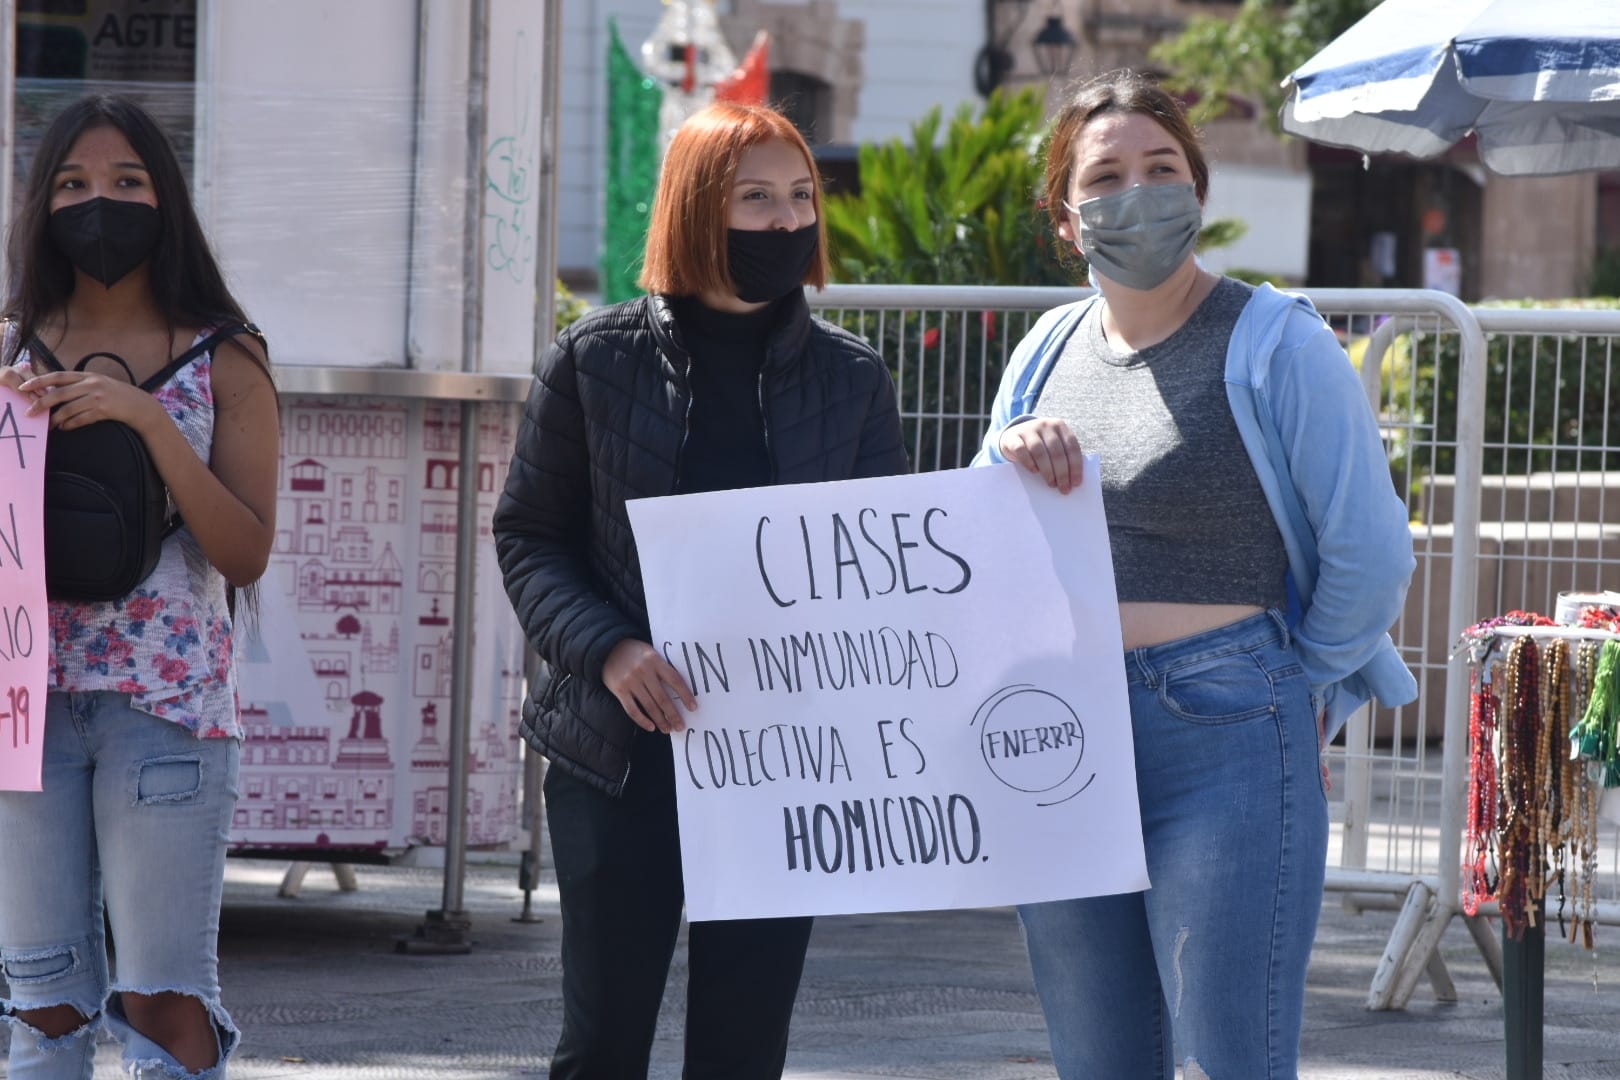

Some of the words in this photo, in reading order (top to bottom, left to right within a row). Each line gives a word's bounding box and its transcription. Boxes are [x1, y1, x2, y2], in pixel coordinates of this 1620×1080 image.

[756, 508, 971, 607] CLASES
[0, 605, 32, 661] IO
[748, 627, 958, 693] INMUNIDAD
[685, 724, 852, 789] COLECTIVA
[877, 718, 926, 778] ES
[985, 721, 1083, 759] FNERRR
[783, 794, 988, 874] HOMICIDIO.
